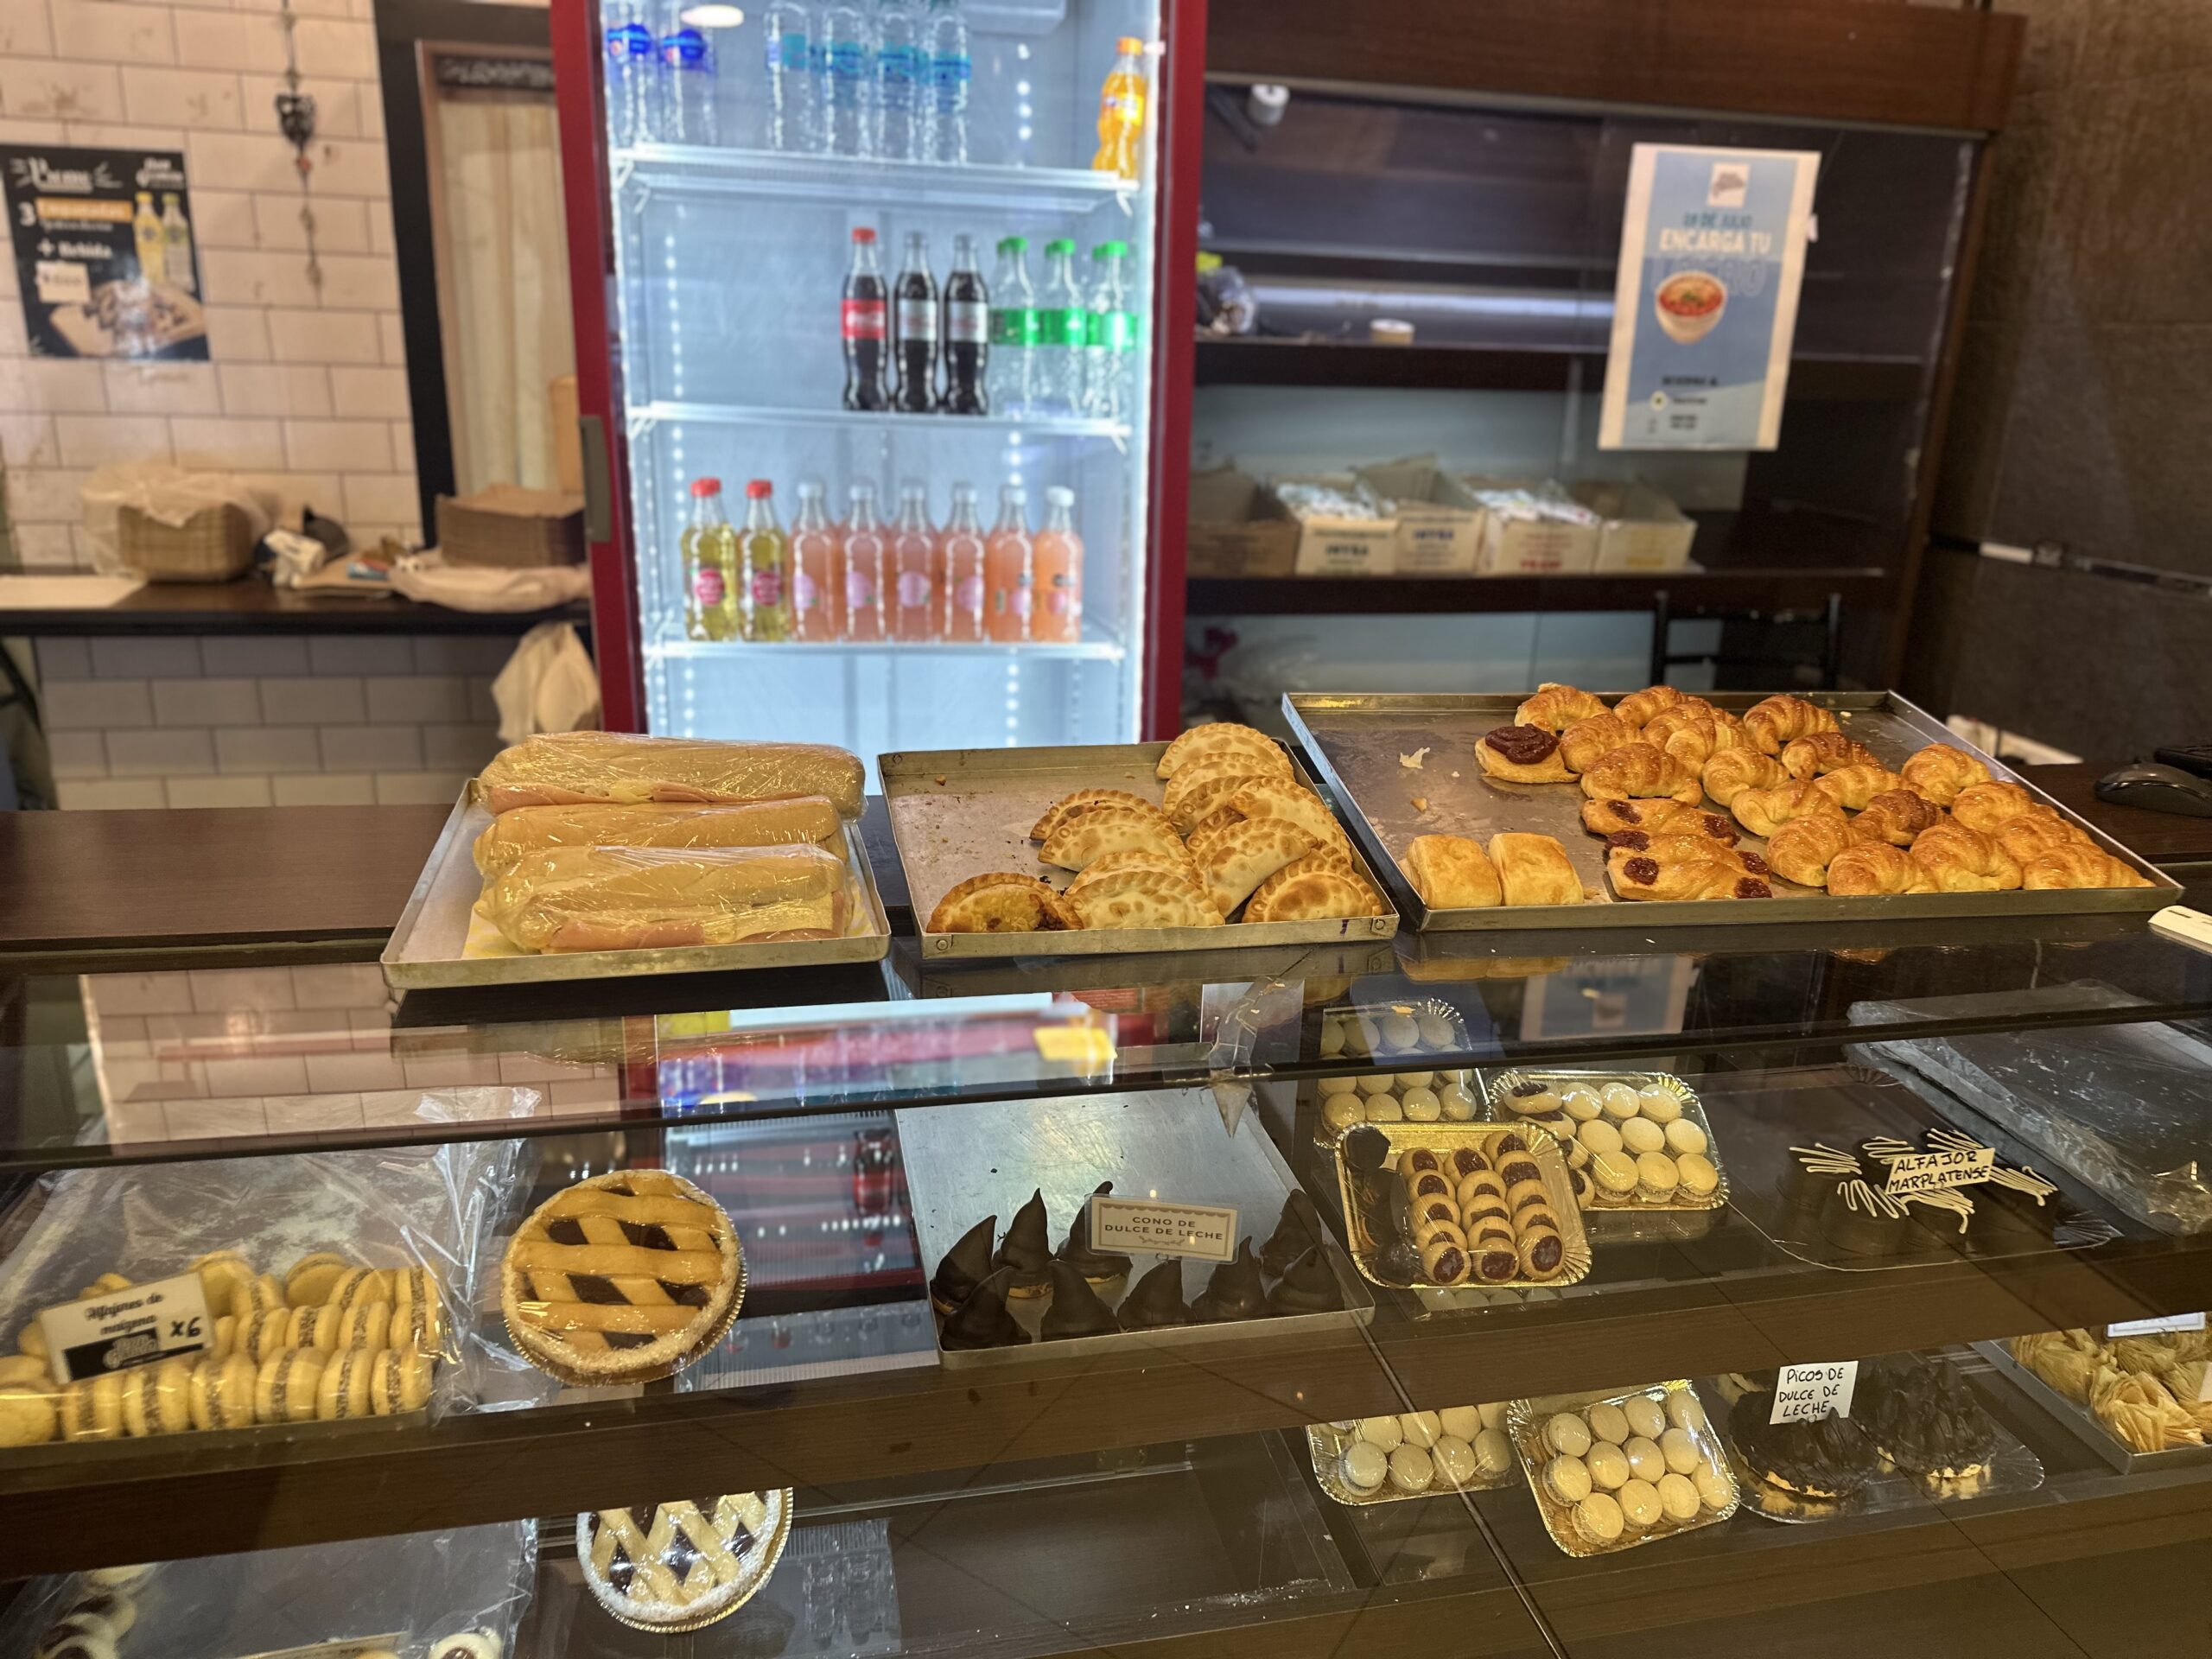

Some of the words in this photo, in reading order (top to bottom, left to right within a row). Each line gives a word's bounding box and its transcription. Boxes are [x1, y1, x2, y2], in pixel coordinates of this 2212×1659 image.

[18, 201, 36, 226] 3
[1660, 229, 1745, 253] ENCARGA
[1750, 232, 1772, 255] TU
[1894, 1150, 1978, 1175] ALFAJOR
[1888, 1166, 1991, 1192] MARPLATENSE
[1132, 1217, 1173, 1226] CONO
[1178, 1219, 1196, 1228] DE
[1104, 1224, 1150, 1234] DULCE
[1155, 1227, 1173, 1236] DE
[1179, 1229, 1224, 1241] LECHE
[146, 1292, 166, 1305] de
[1828, 1367, 1845, 1381] DE
[1779, 1389, 1815, 1402] DULCE
[1822, 1384, 1840, 1397] DE
[1783, 1401, 1830, 1417] LECHE
